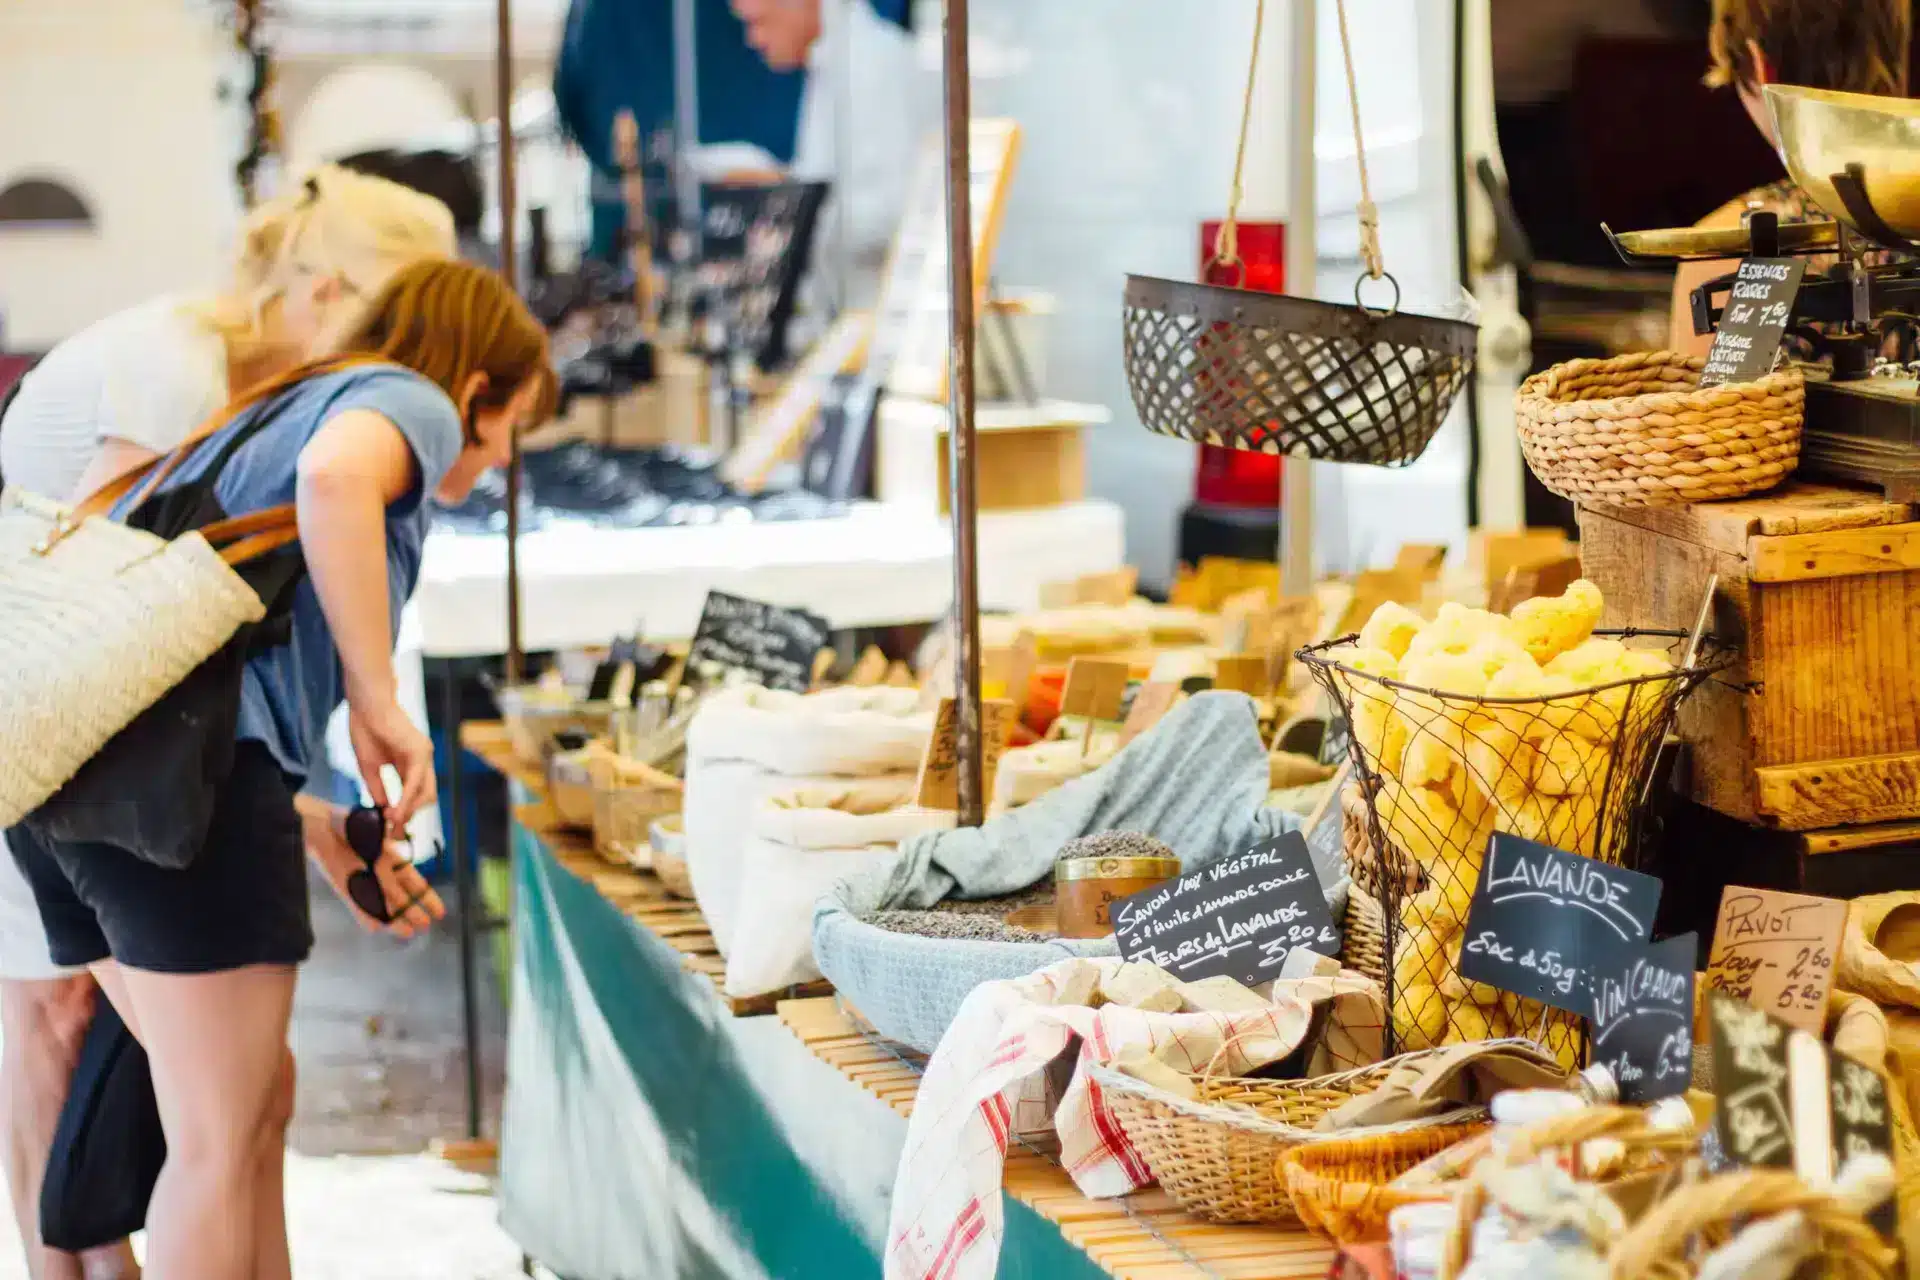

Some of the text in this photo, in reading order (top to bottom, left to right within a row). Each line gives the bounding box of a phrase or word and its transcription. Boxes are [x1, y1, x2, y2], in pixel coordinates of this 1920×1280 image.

[1738, 263, 1791, 281] ESSENCES
[1733, 281, 1771, 299] RARES
[1730, 303, 1754, 324] 5ml
[1487, 836, 1630, 904] LAVANDE
[1117, 889, 1171, 936] SAVON
[1174, 872, 1202, 897] 100%
[1209, 848, 1283, 882] VÉGÉTAL
[1204, 932, 1222, 950] de
[1217, 900, 1308, 943] LAVANDE
[1725, 894, 1822, 939] PAVOT
[1129, 932, 1143, 948] à
